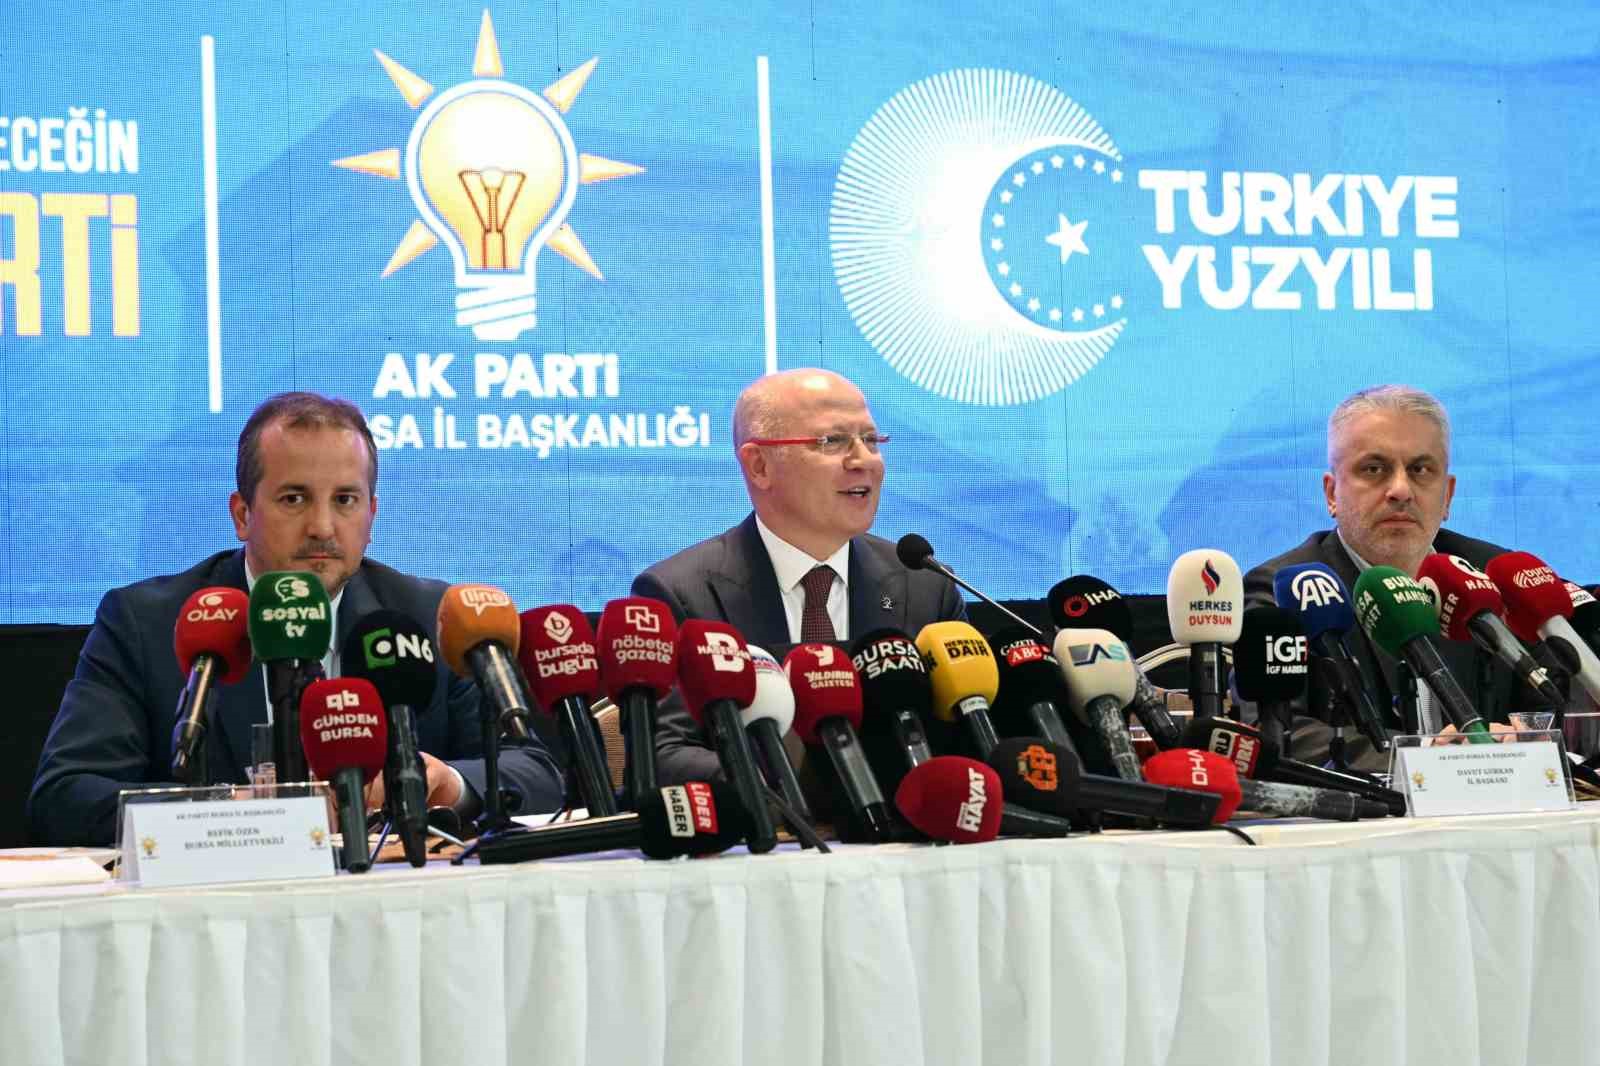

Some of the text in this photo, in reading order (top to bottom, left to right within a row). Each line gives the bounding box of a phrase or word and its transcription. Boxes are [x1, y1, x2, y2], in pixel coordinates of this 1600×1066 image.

[372, 352, 457, 398] AK
[434, 405, 467, 448] İL
[477, 404, 711, 459] BAŞKANLIĞI
[1301, 577, 1344, 611] AA
[187, 608, 239, 622] OLAY
[1190, 600, 1232, 611] HERKES
[285, 622, 307, 637] tv
[1189, 614, 1232, 626] DUYSUN
[535, 641, 595, 661] bursada
[616, 648, 672, 665] gazete
[853, 640, 920, 671] BURSA
[1012, 646, 1042, 662] ABC
[538, 655, 599, 678] bugün
[320, 726, 373, 742] BURSA
[961, 767, 987, 832] HAYAT
[669, 788, 688, 833] HABER
